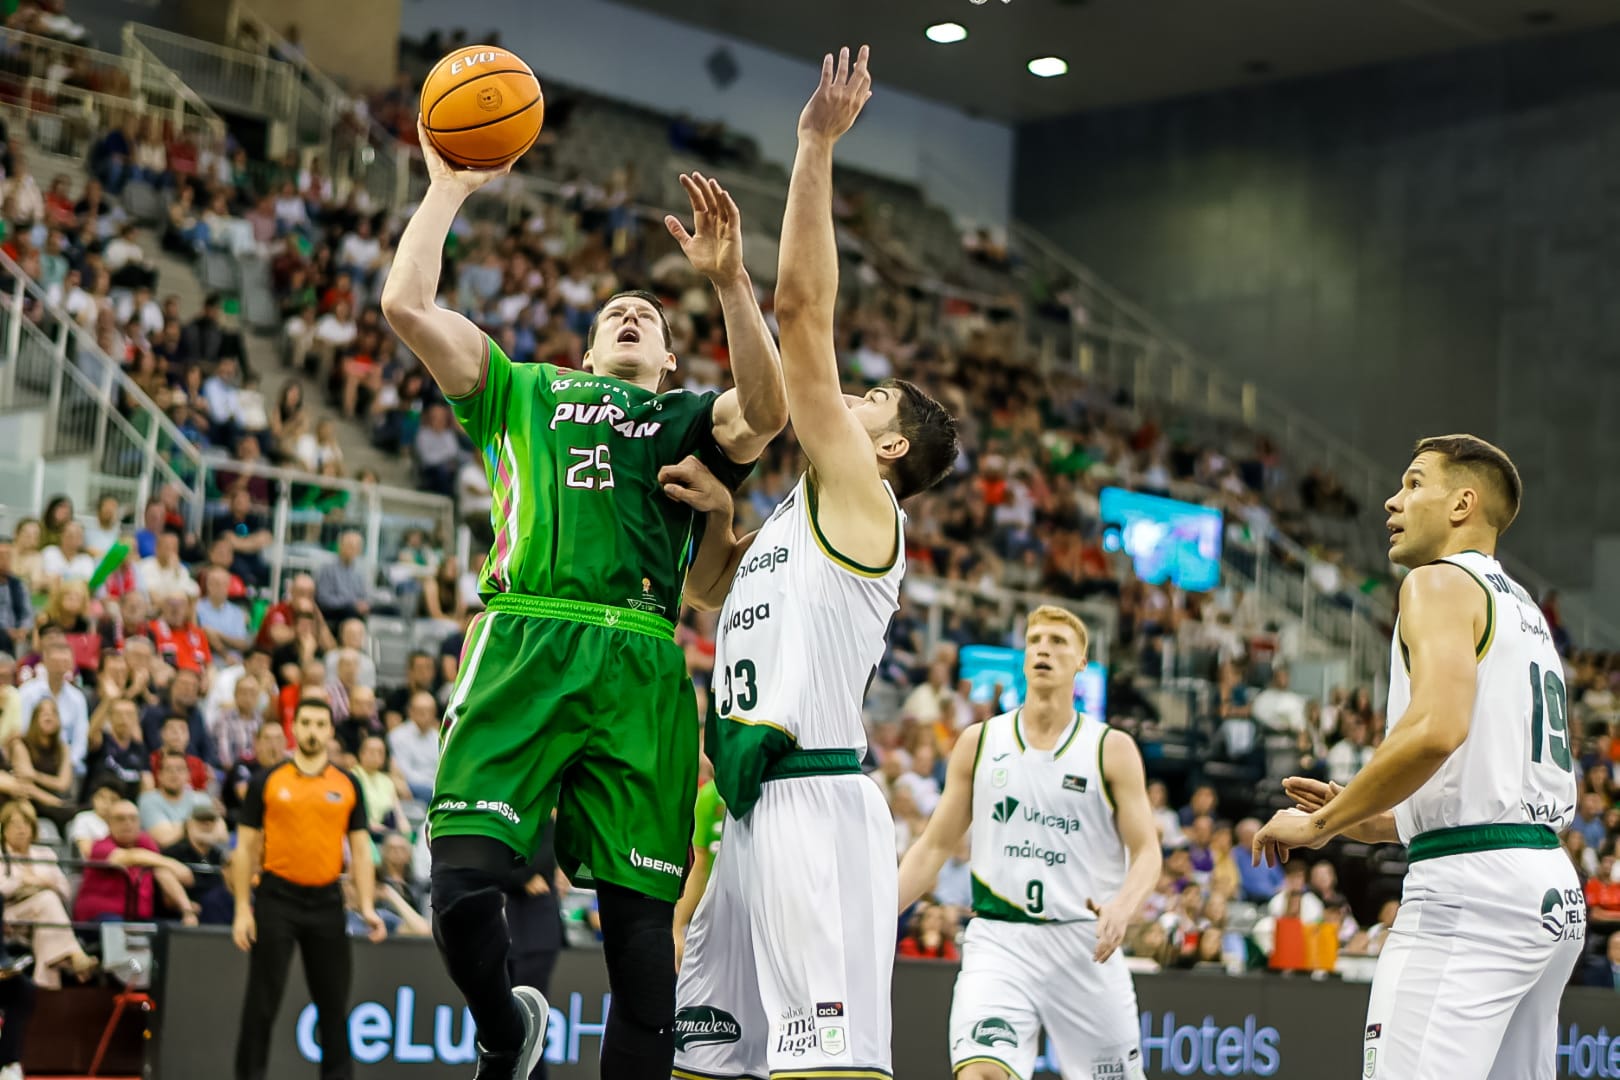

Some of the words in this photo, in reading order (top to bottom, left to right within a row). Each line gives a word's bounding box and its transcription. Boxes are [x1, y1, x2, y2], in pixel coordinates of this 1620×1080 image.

[451, 52, 496, 75] EVO
[734, 546, 789, 584] nicaja
[1530, 661, 1572, 773] 19
[438, 800, 467, 809] vive
[1026, 879, 1045, 915] 9
[675, 1010, 738, 1035] amadesa
[818, 1007, 838, 1016] acb
[1556, 1023, 1620, 1079] Hote
